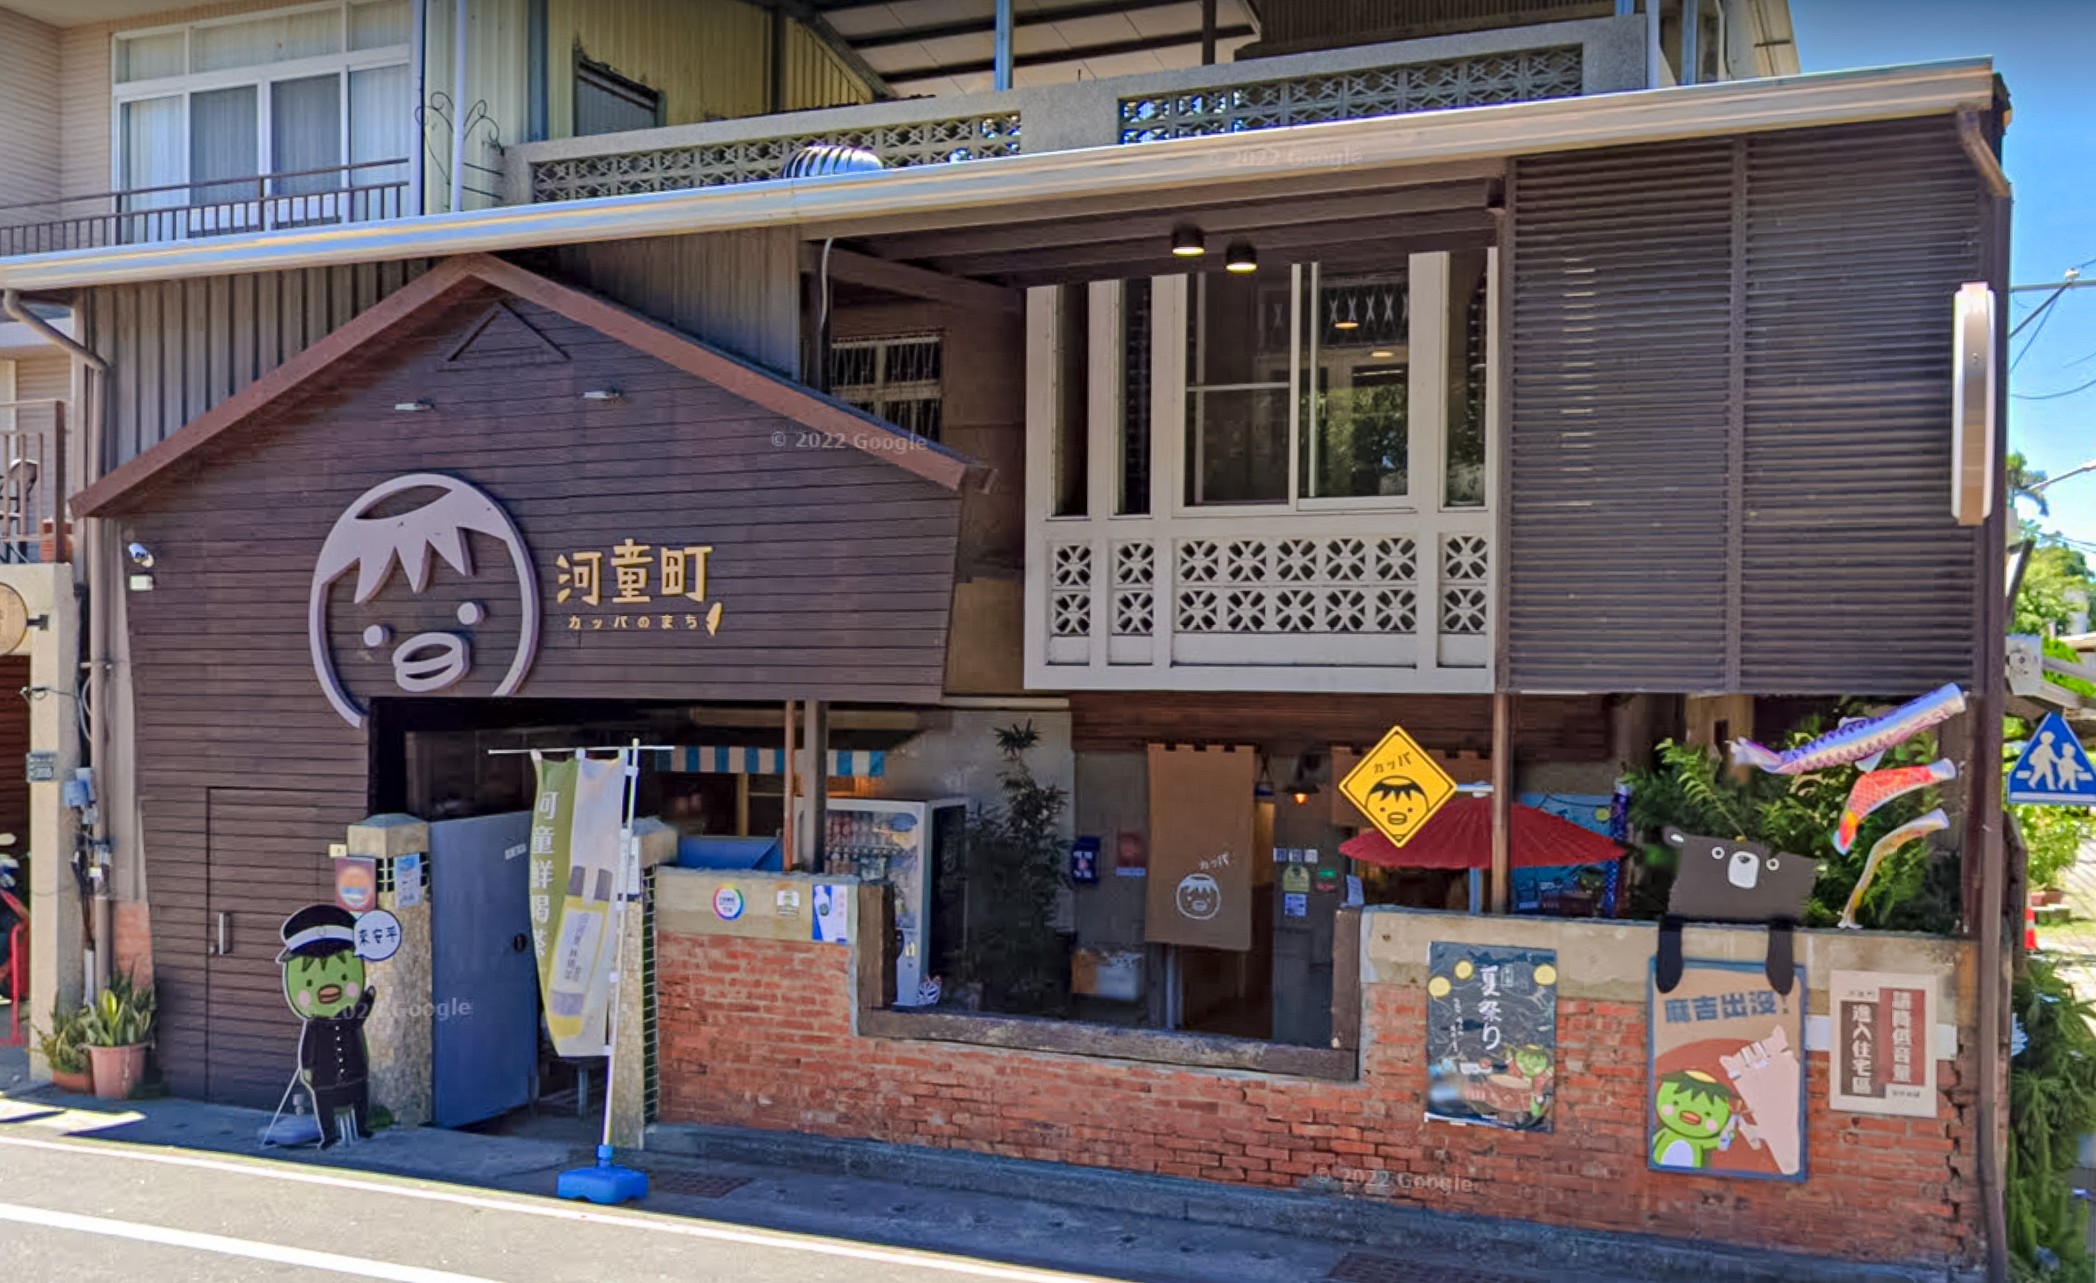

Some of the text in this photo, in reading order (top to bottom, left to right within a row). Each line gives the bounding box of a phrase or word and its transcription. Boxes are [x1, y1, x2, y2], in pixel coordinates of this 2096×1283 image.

[556, 538, 713, 606] 河童町
[568, 615, 698, 630] カッパのまち
